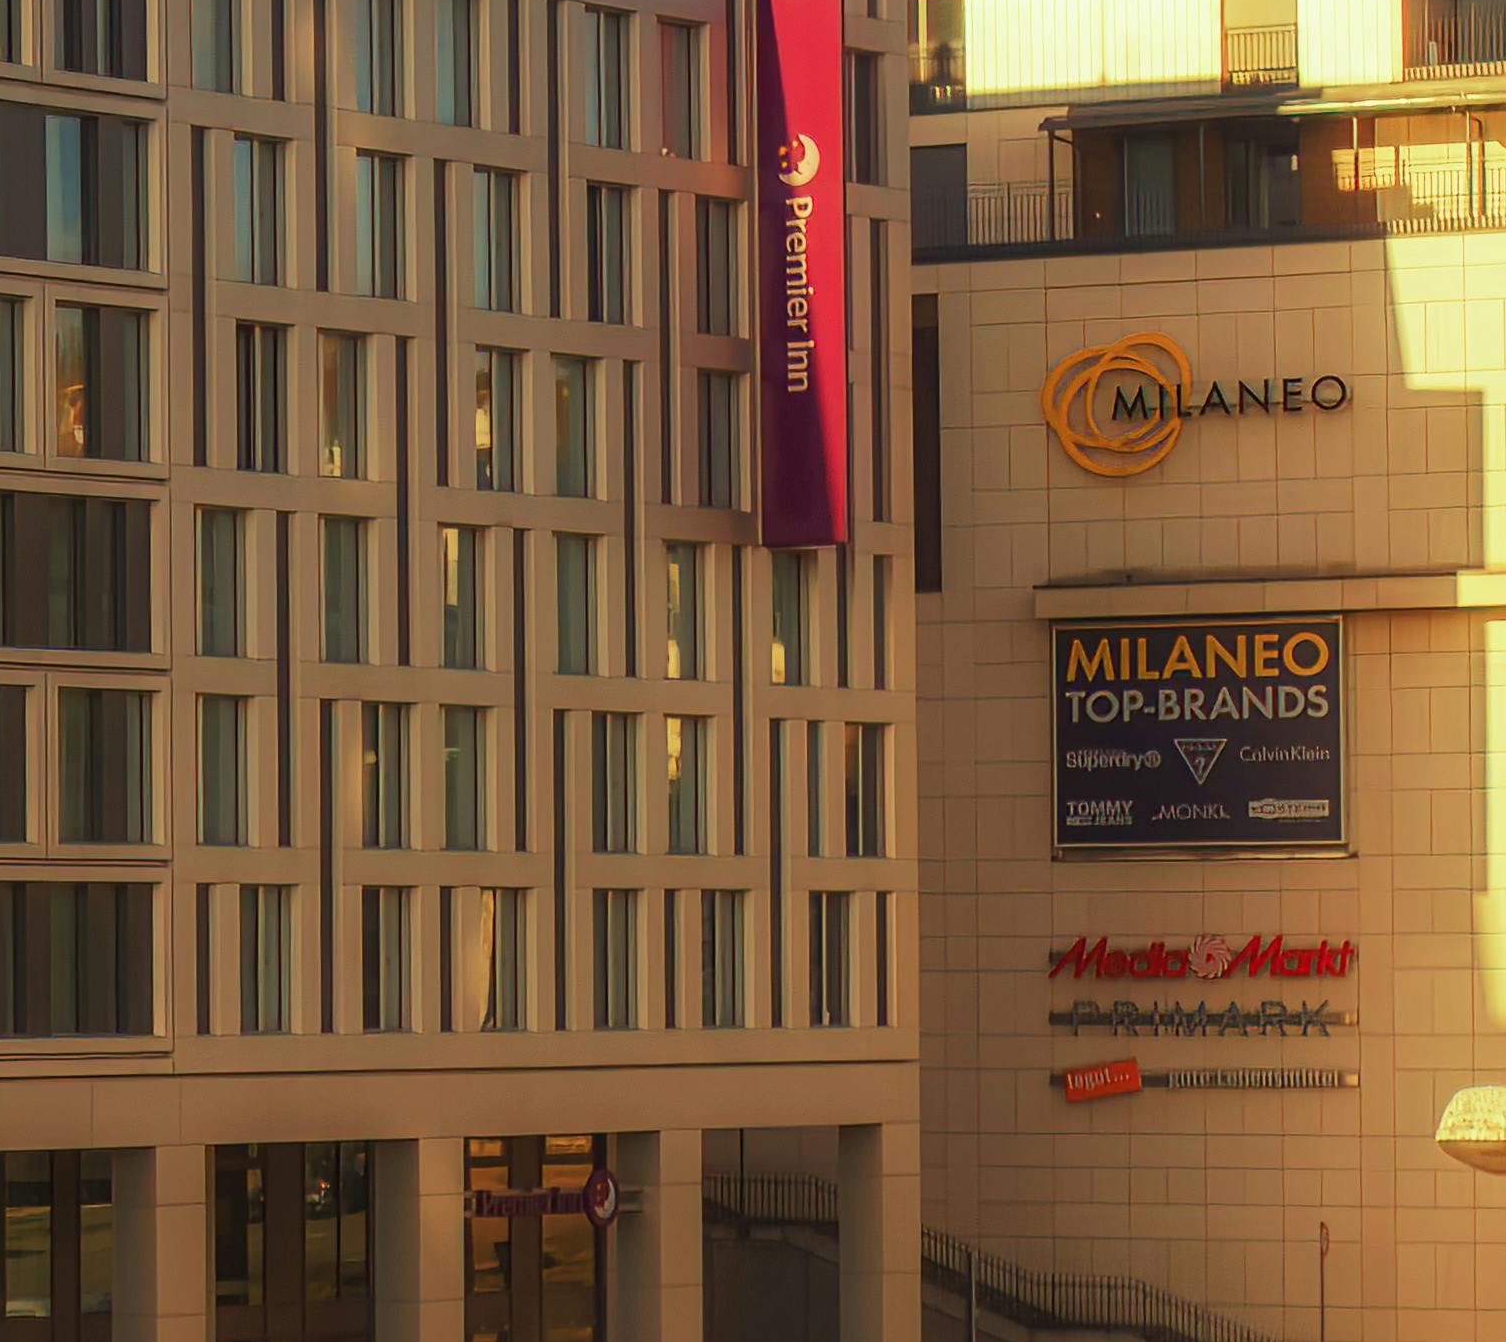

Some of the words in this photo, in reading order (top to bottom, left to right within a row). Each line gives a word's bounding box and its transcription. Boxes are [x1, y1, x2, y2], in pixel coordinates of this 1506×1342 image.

[785, 195, 815, 333] Premier
[787, 340, 815, 393] Inn
[1111, 375, 1348, 421] MILANEO
[1066, 632, 1330, 683] MILANEO
[1065, 684, 1330, 724] TOP-BRANDS
[1072, 1000, 1331, 1038] PRIMARK
